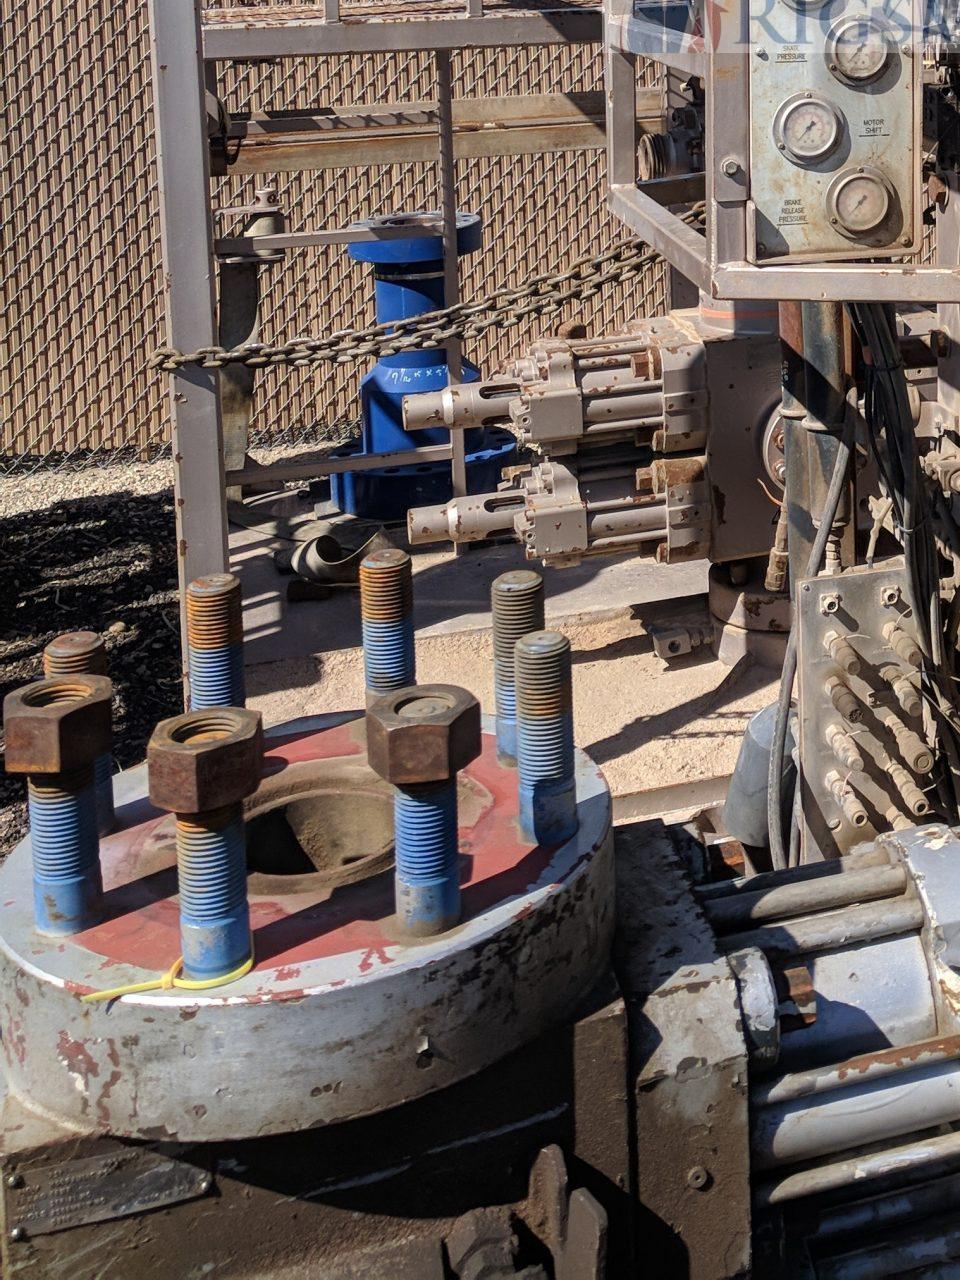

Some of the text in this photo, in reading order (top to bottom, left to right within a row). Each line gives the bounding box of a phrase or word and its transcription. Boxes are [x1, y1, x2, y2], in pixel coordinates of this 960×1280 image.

[863, 118, 884, 126] MOTOR
[865, 126, 882, 134] SHIFT
[784, 198, 802, 206] BRAKE
[781, 207, 805, 215] RELEASE
[778, 214, 807, 223] PRESSURE
